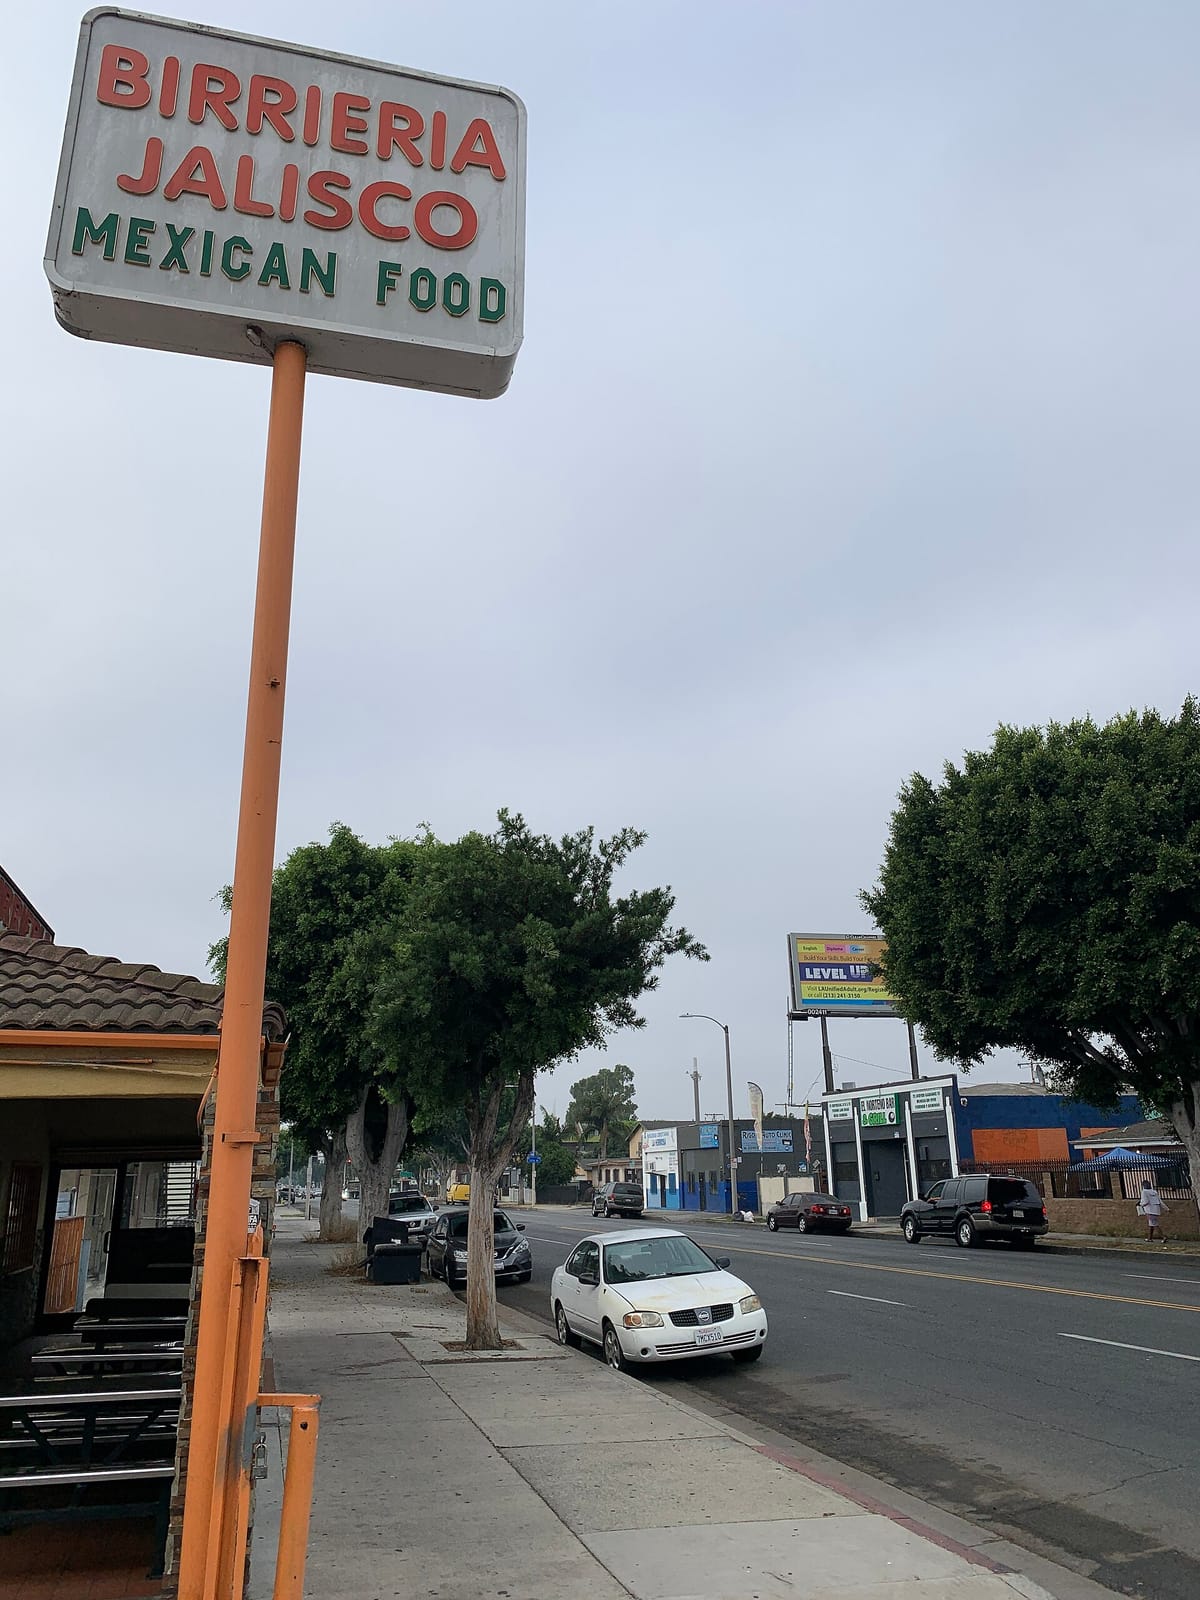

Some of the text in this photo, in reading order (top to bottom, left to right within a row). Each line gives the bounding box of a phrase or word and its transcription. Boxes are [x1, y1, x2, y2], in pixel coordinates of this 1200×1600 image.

[97, 44, 507, 180] BIRRIERIA
[116, 137, 479, 251] JALISCO
[72, 207, 507, 323] MEXICAN FOOD
[805, 965, 870, 980] LEVEL UP
[868, 1111, 887, 1126] GRILL
